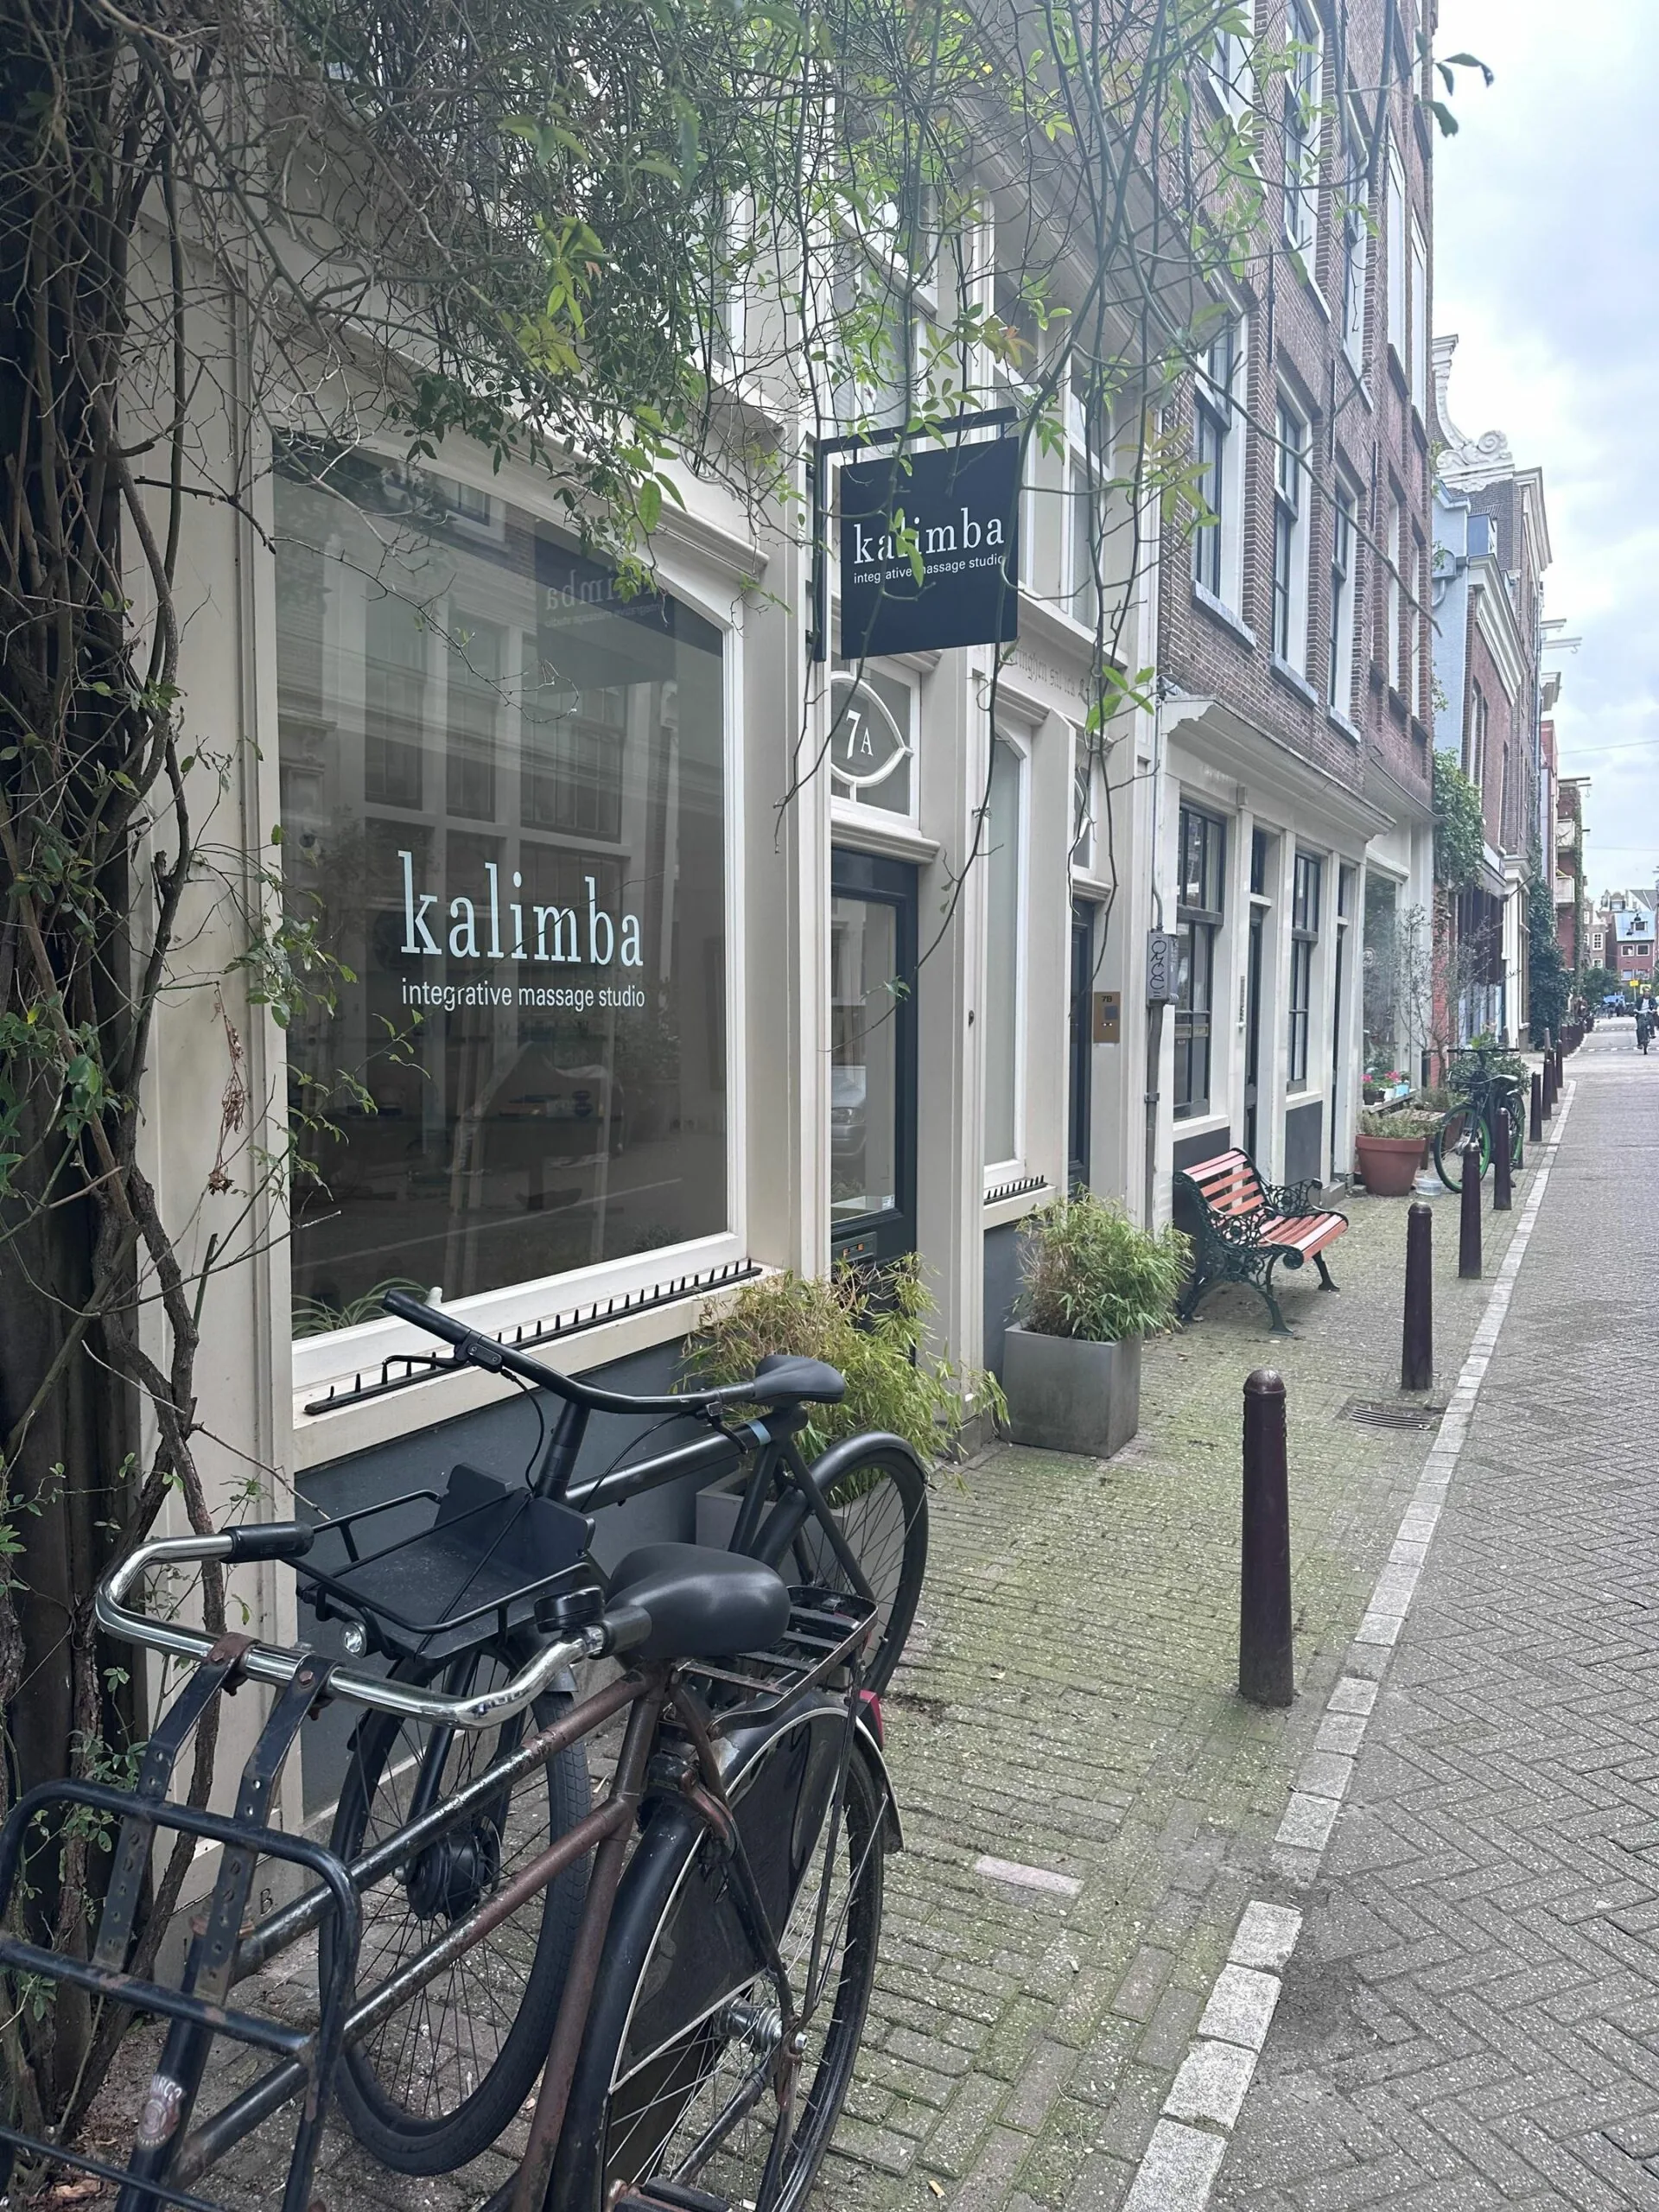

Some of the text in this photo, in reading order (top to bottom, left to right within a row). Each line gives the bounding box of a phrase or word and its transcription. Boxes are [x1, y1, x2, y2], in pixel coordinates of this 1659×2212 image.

[854, 567, 912, 584] integative
[918, 560, 966, 575] assage
[397, 849, 644, 967] kalimba
[402, 977, 645, 1013] integrative massage studio
